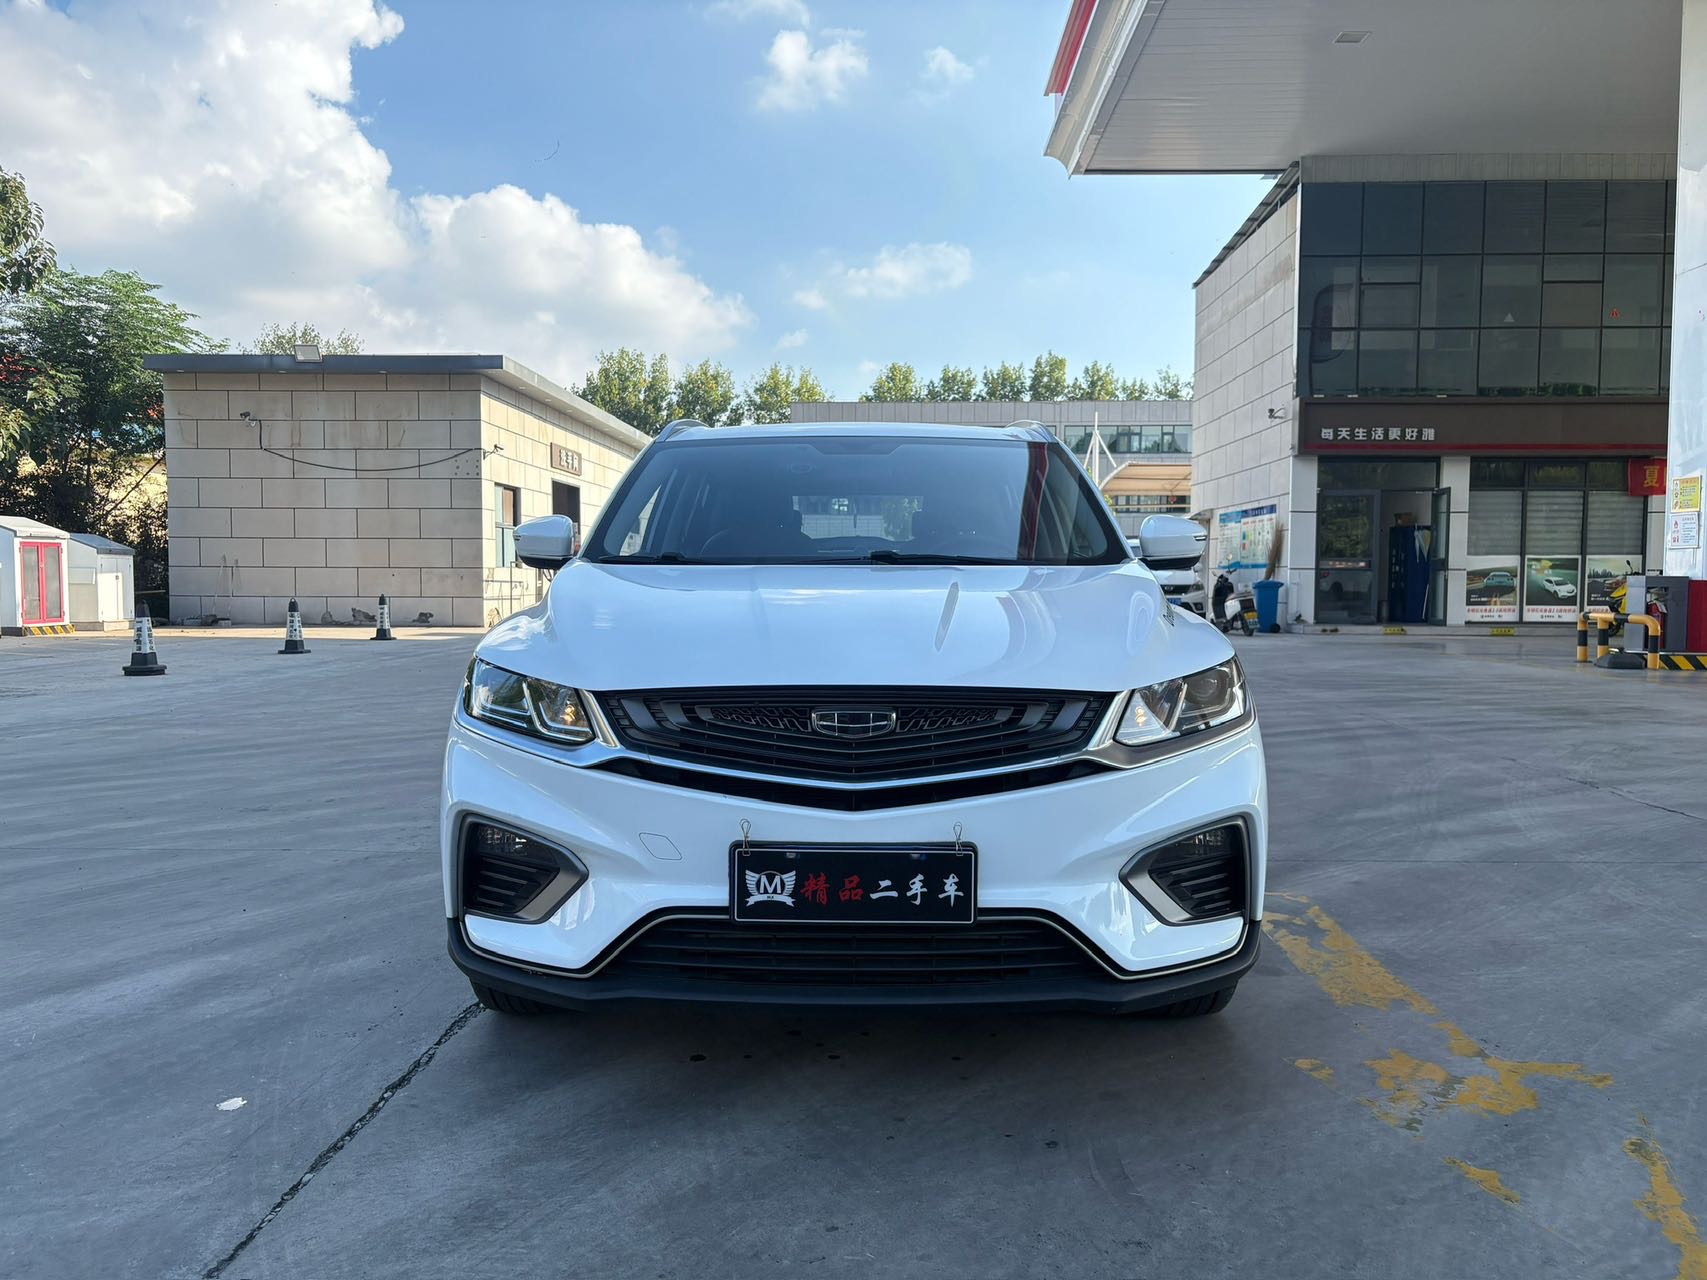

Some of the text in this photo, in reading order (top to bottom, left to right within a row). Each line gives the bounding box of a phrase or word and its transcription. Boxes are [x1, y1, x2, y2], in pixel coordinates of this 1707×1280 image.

[1643, 465, 1667, 487] 夏
[759, 875, 782, 894] M
[801, 872, 964, 906] 精品二手车
